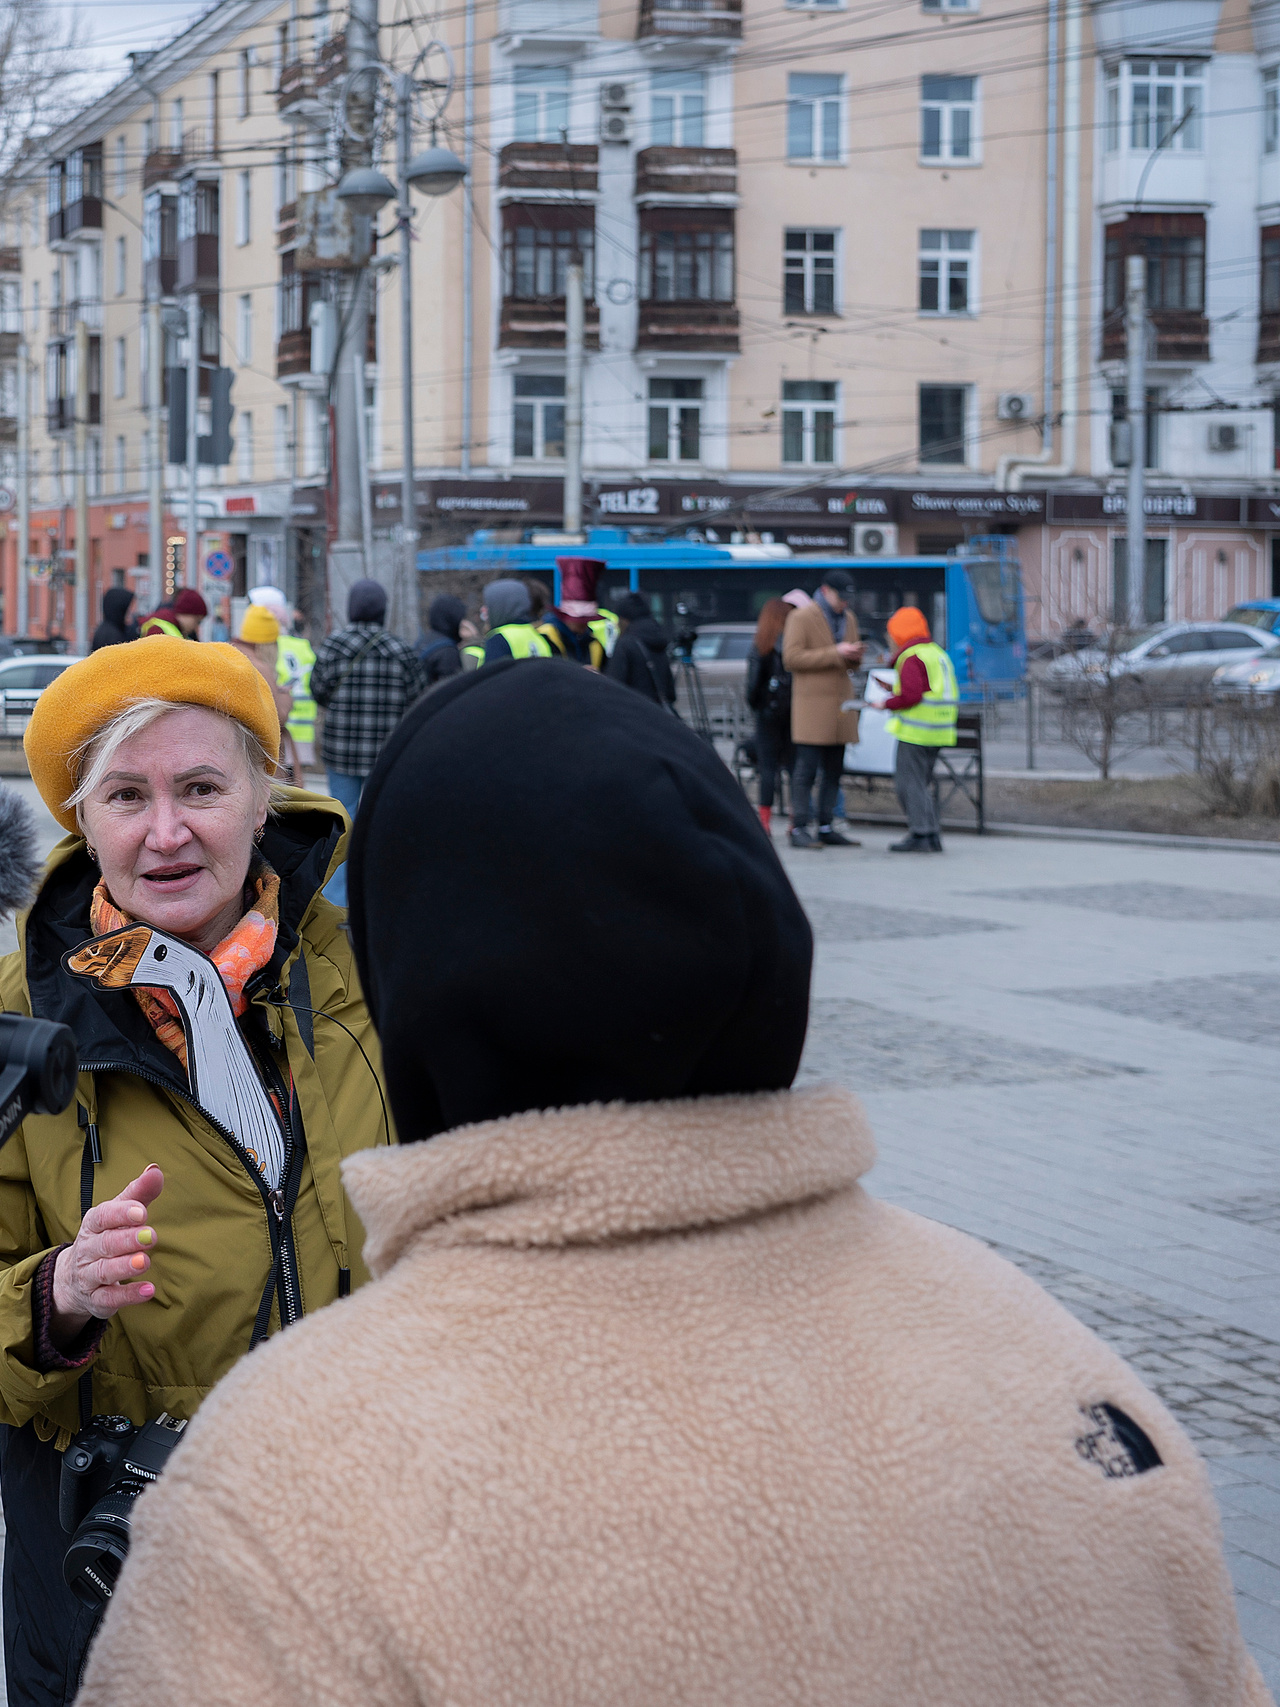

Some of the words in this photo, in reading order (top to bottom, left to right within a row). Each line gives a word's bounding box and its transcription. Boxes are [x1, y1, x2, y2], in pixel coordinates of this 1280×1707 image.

[598, 488, 660, 514] TELE2
[984, 497, 1005, 512] on
[1005, 494, 1043, 516] Style
[1103, 494, 1197, 516] БРОБРЕЙ
[125, 1463, 157, 1480] Canon
[84, 1566, 113, 1598] Canon
